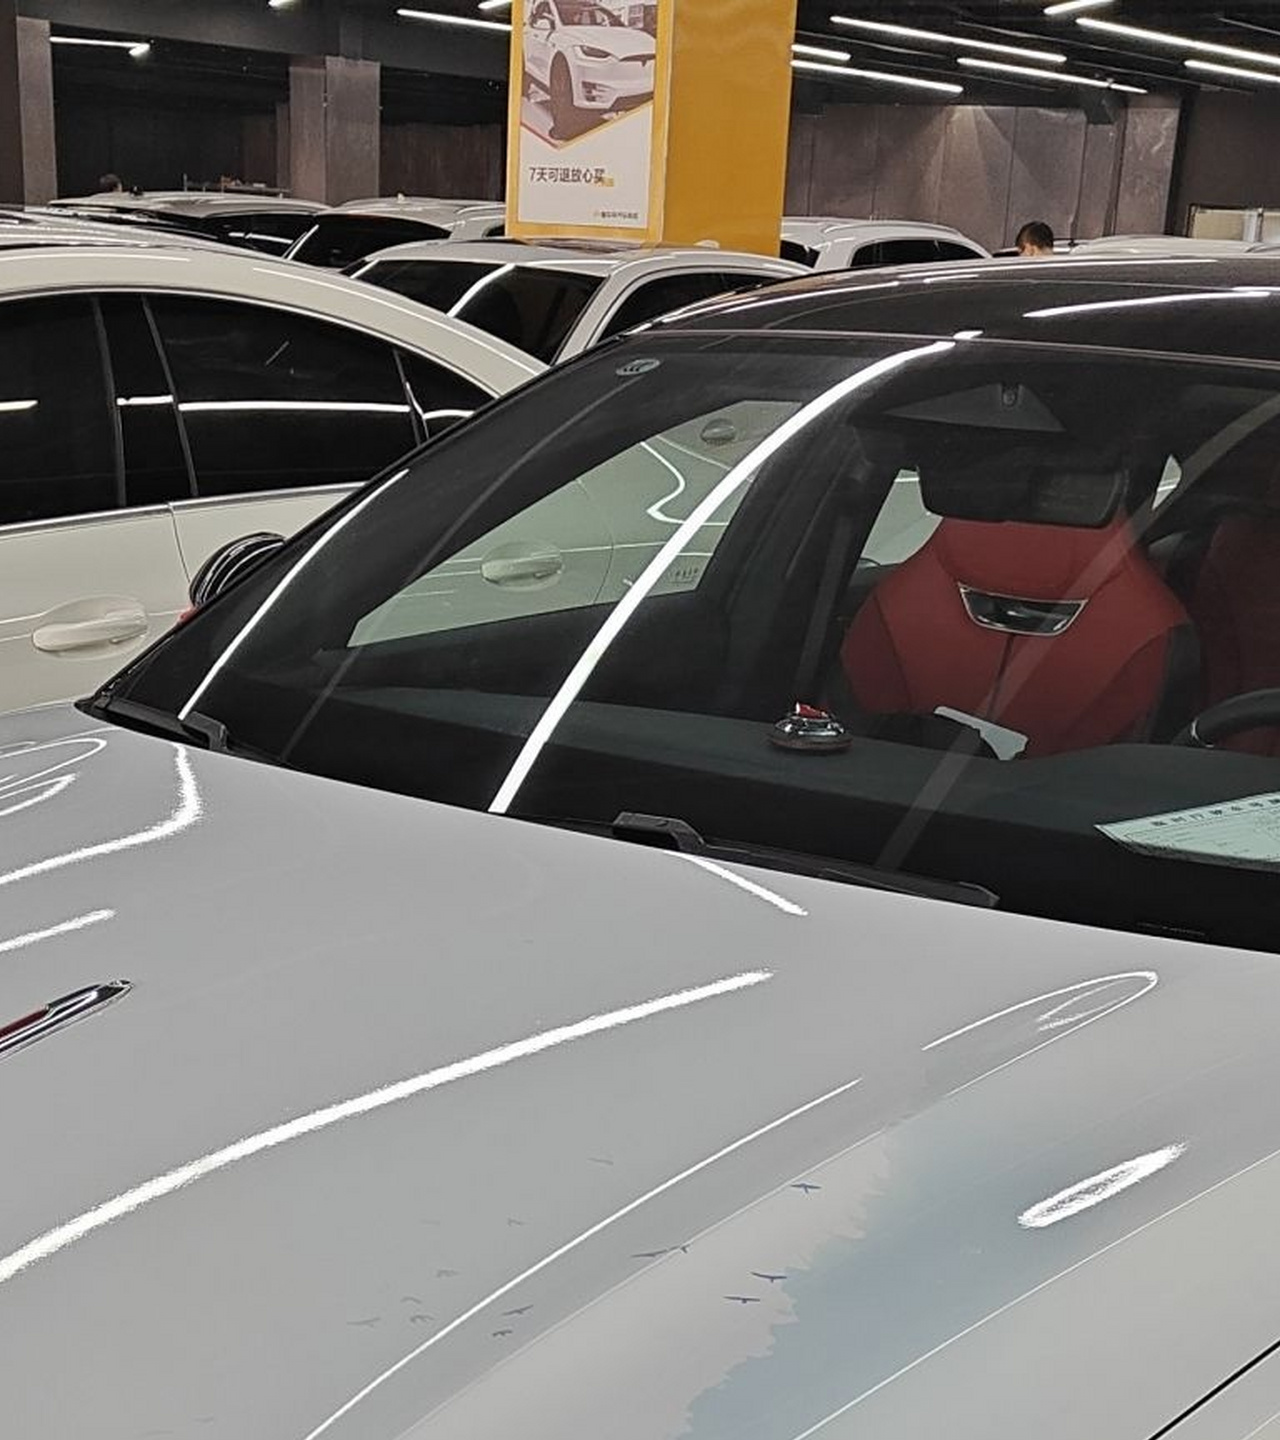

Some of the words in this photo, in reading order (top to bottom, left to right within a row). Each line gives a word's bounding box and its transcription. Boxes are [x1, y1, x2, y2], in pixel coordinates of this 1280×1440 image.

[529, 166, 606, 184] 7天可退放心买
